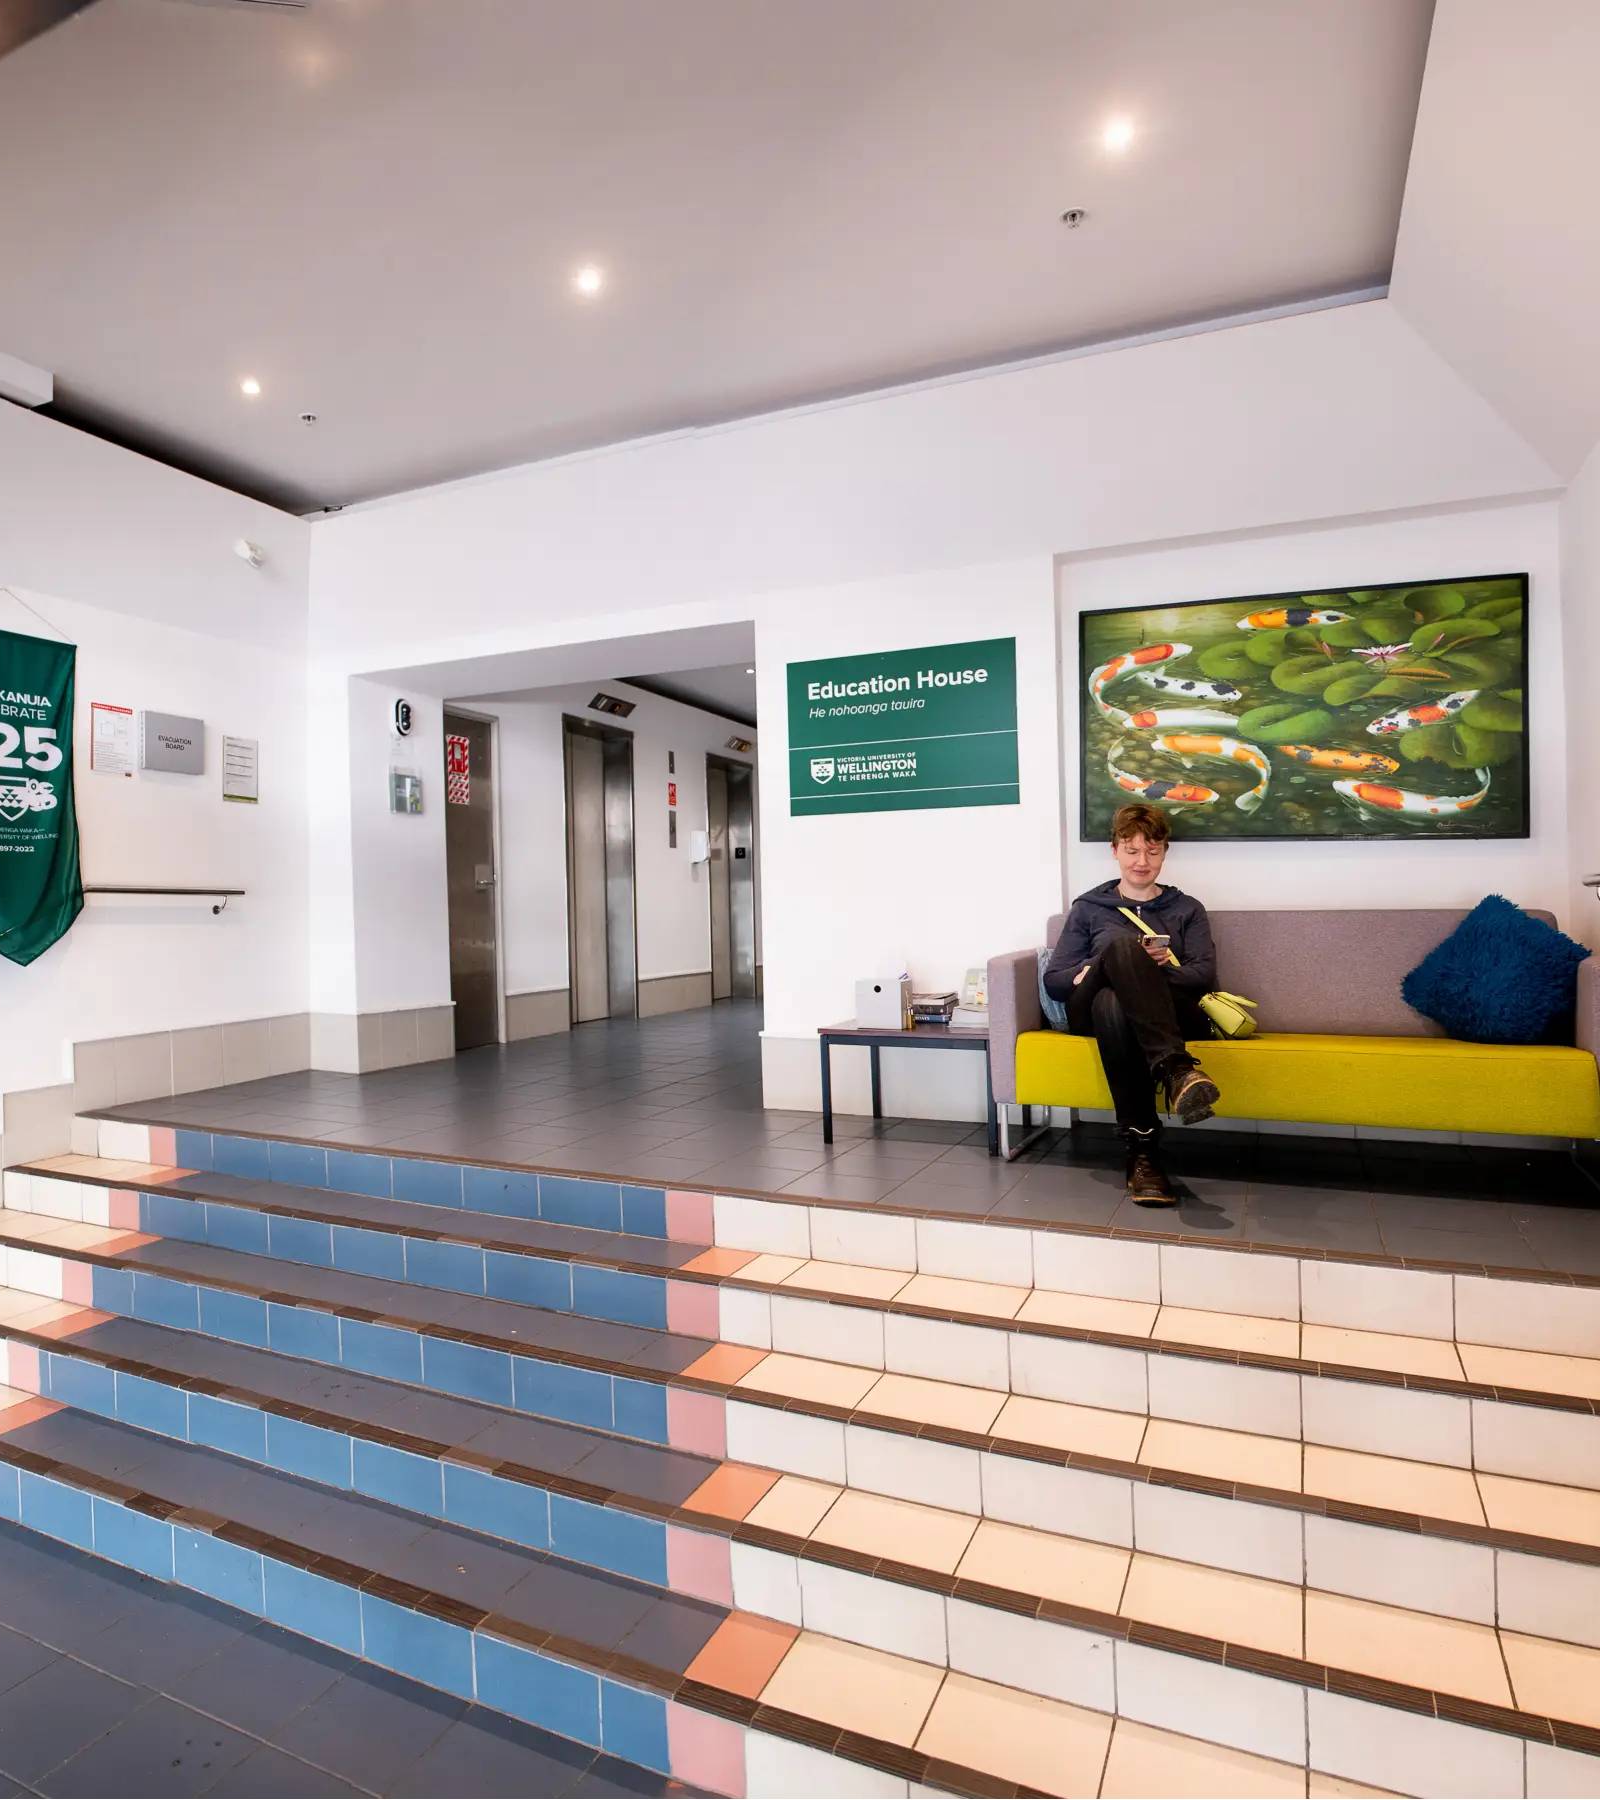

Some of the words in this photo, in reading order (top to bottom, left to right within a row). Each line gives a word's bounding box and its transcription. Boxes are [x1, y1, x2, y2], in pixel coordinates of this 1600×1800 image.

[807, 675, 911, 701] Education
[917, 668, 988, 689] House
[809, 707, 826, 719] He
[828, 703, 888, 717] nohoanga
[891, 698, 925, 710] tauira
[158, 734, 192, 745] EVACUATION
[165, 742, 185, 751] BOARD
[836, 755, 865, 763] VICTORIA
[867, 752, 906, 761] UNIVERSITY
[837, 759, 917, 775] WELLINGTON
[849, 772, 890, 781] HERENGA
[892, 770, 917, 778] WAKA
